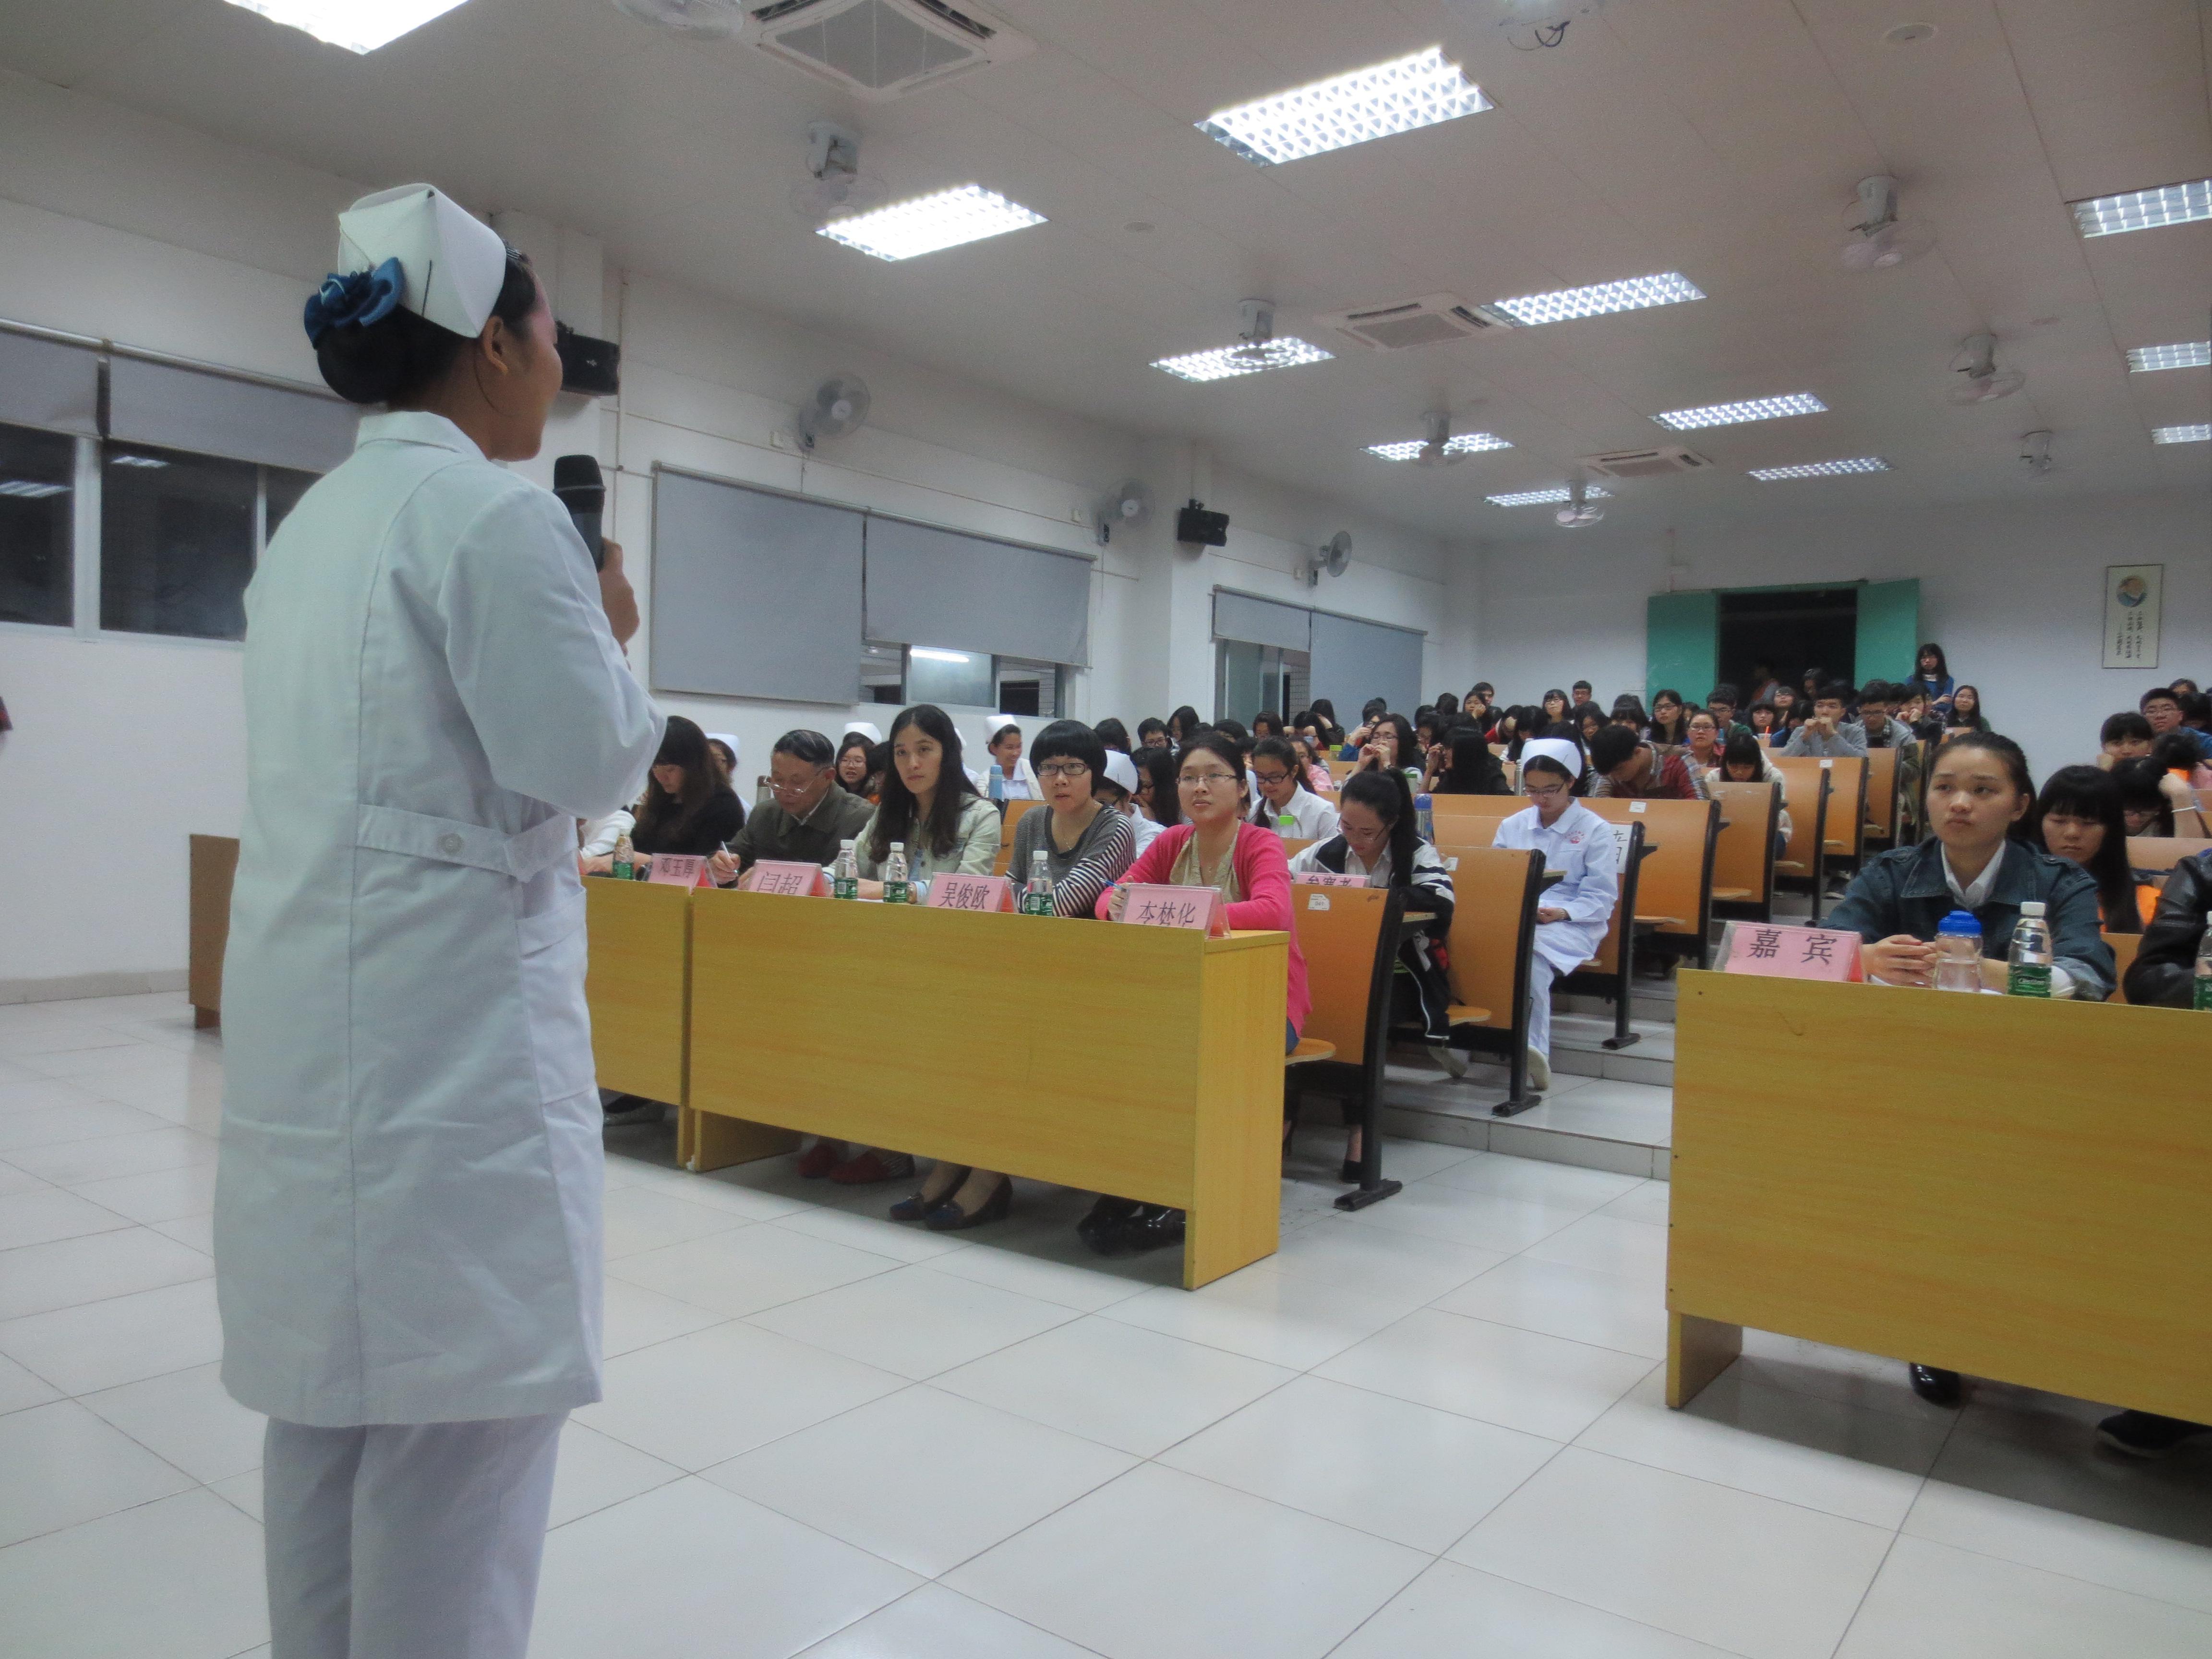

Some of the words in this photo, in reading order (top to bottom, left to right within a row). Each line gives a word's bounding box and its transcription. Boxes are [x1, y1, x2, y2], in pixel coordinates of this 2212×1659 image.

[757, 871, 803, 895] 闫超
[938, 881, 990, 910] 吴俊欧
[1746, 929, 1838, 965] 嘉宾
